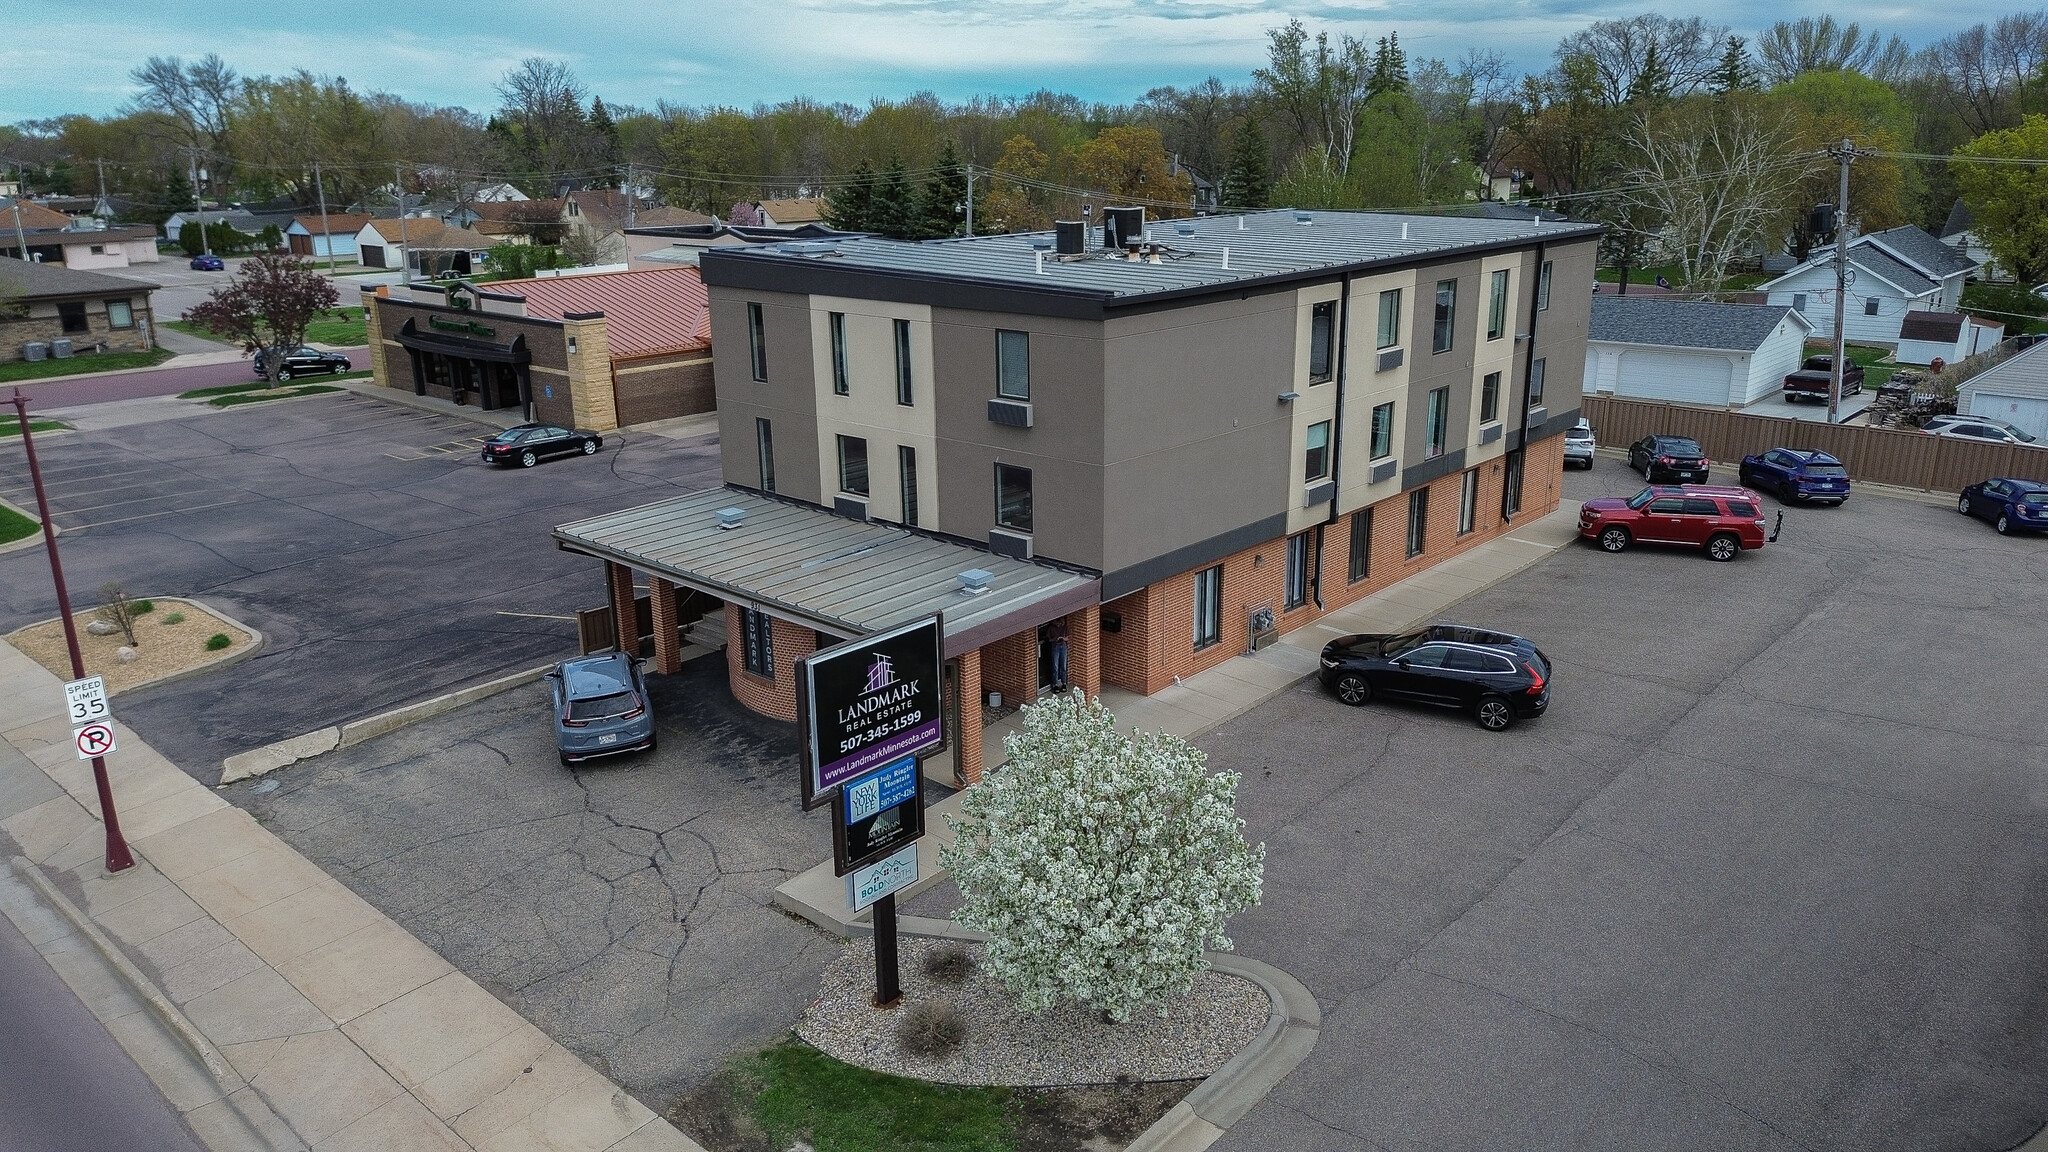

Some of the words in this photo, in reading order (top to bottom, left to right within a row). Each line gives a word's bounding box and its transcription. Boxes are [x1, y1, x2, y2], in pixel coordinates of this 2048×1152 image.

[748, 608, 758, 667] ANDMARK
[764, 614, 773, 672] EALTORS
[67, 681, 101, 694] SPEED
[73, 690, 98, 702] LIMIT
[73, 698, 105, 718] 35
[837, 679, 920, 725] LANDMARK
[846, 717, 872, 733] REAL
[876, 699, 913, 721] ESTATE
[840, 709, 922, 754] 507-345-1599
[824, 726, 936, 780] www.LandmarkMinnesota.com
[852, 789, 878, 807] YORK
[855, 782, 876, 800] NEW
[856, 801, 876, 817] LIFE
